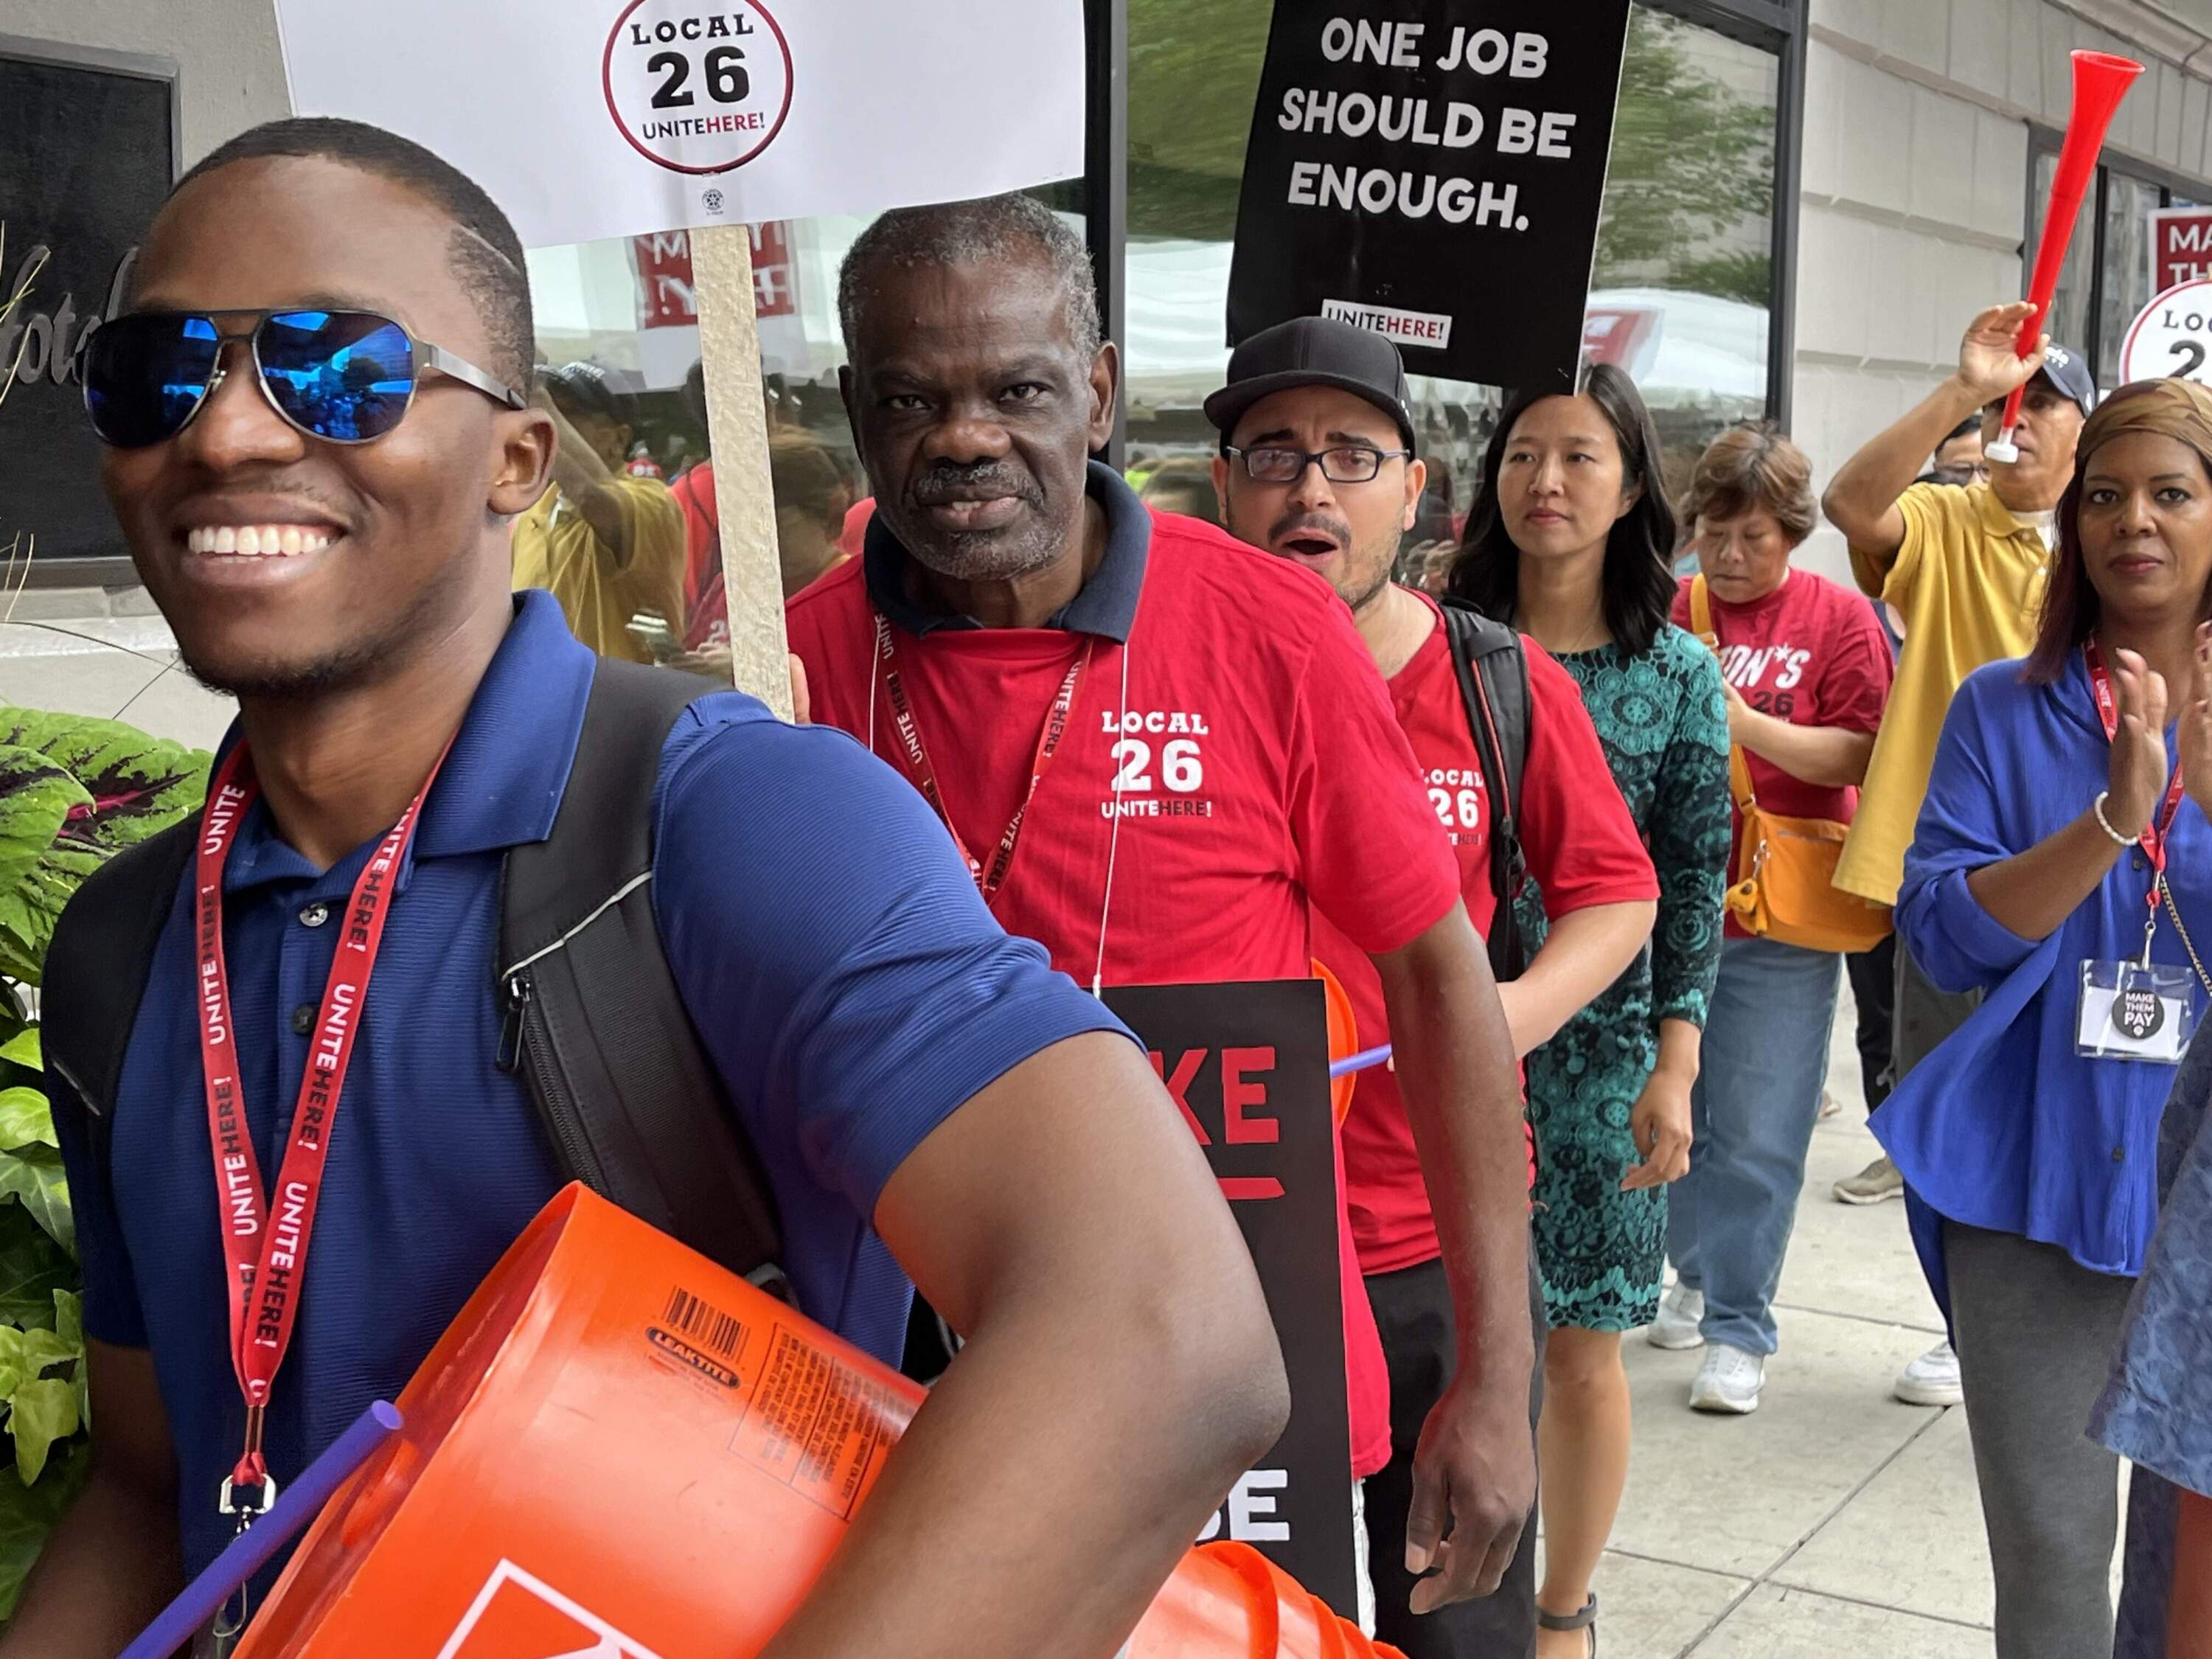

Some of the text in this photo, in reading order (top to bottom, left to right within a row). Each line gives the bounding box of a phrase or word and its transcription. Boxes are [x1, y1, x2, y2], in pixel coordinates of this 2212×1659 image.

[630, 13, 754, 45] LOCAL
[1321, 17, 1548, 78] ONE JOB
[647, 46, 749, 108] 26
[642, 112, 765, 139] UNITEHERE!
[1278, 88, 1576, 159] SHOULD BE
[1287, 161, 1529, 232] ENOUGH.
[1102, 711, 1209, 735] LOCAL
[1753, 690, 1794, 716] 26
[1110, 739, 1203, 793] 26
[1101, 800, 1212, 818] UNITEHERE!
[1427, 787, 1478, 829] 26
[2124, 1012, 2154, 1026] PAY
[2126, 993, 2154, 1004] MAKE
[2126, 1002, 2154, 1013] THEM
[298, 983, 356, 1151] UNITEHERE!
[213, 1076, 258, 1236] UNITEHERE!
[254, 1181, 307, 1349] UNITEHERE!
[653, 1331, 734, 1385] LEAKTITE
[1195, 1470, 1290, 1541] E
